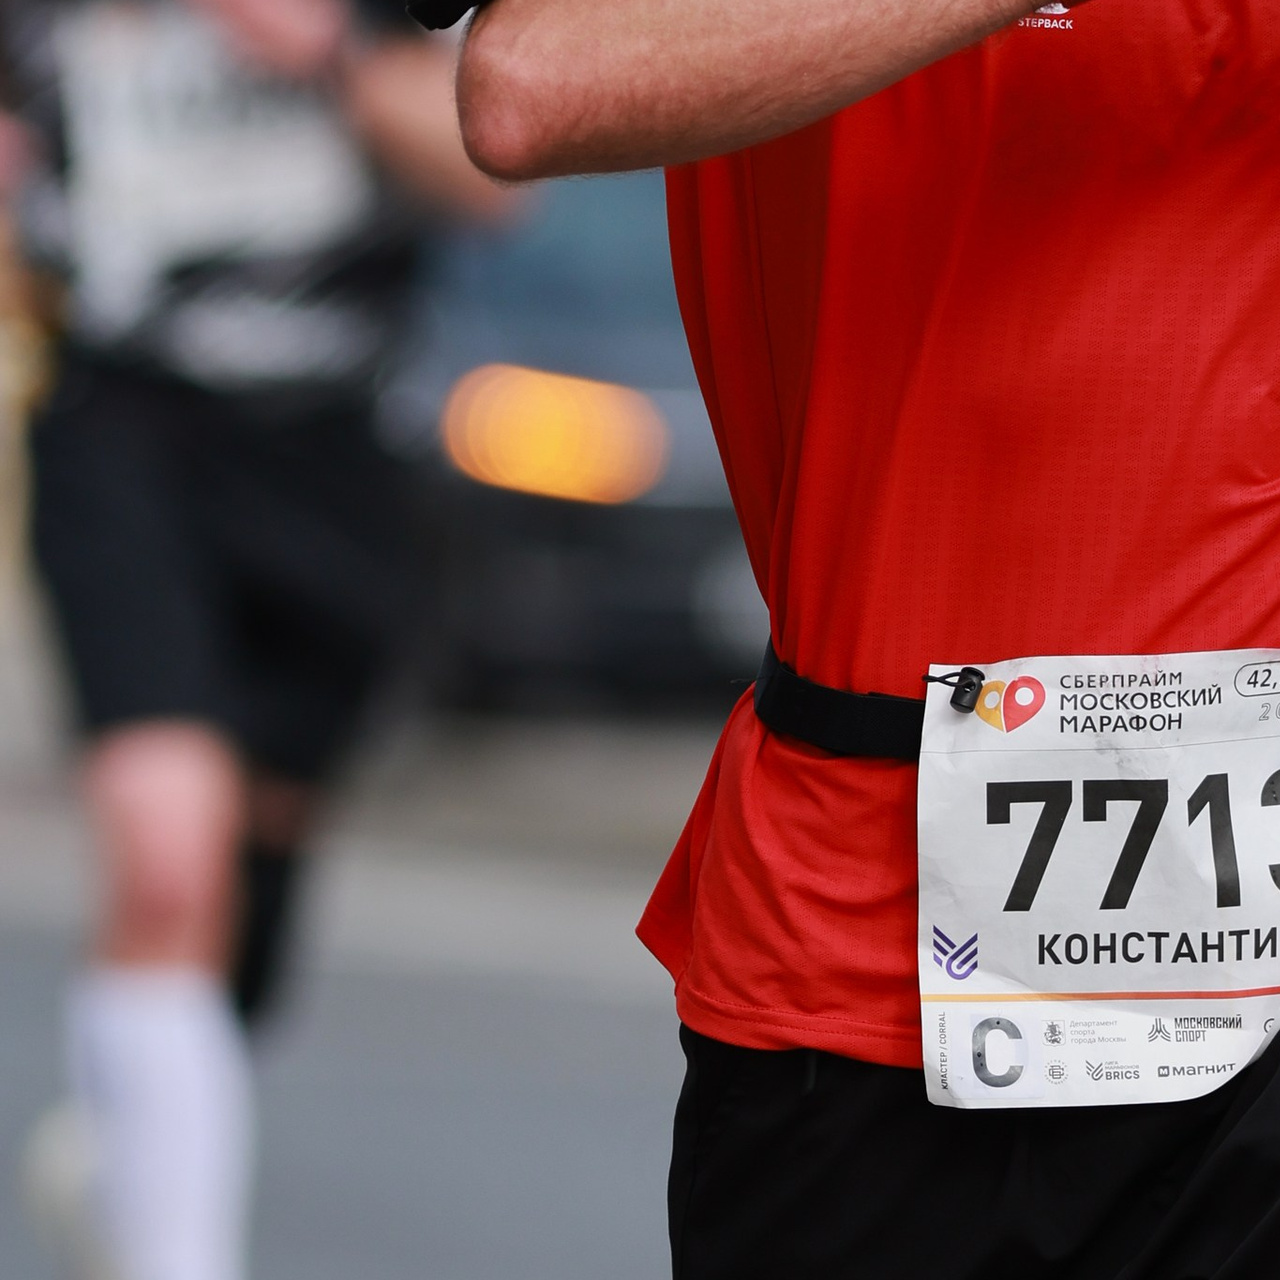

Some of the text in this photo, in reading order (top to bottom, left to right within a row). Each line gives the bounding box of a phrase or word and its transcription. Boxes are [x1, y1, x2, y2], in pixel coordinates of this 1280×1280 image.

[1018, 18, 1073, 29] STEPBACK
[1060, 670, 1182, 688] СБЕРПРАЙМ
[1060, 684, 1222, 711] МОСКОВСКИЙ
[1060, 713, 1182, 733] МАРАФОН
[1070, 1020, 1117, 1028] Департамент
[1174, 1014, 1242, 1029] МОСКОВСКИЙ
[1070, 1029, 1095, 1037] спорта
[1175, 1030, 1206, 1042] СПОРТ
[940, 1051, 949, 1090] КЛАСТЕР
[1105, 1070, 1140, 1081] BRICS
